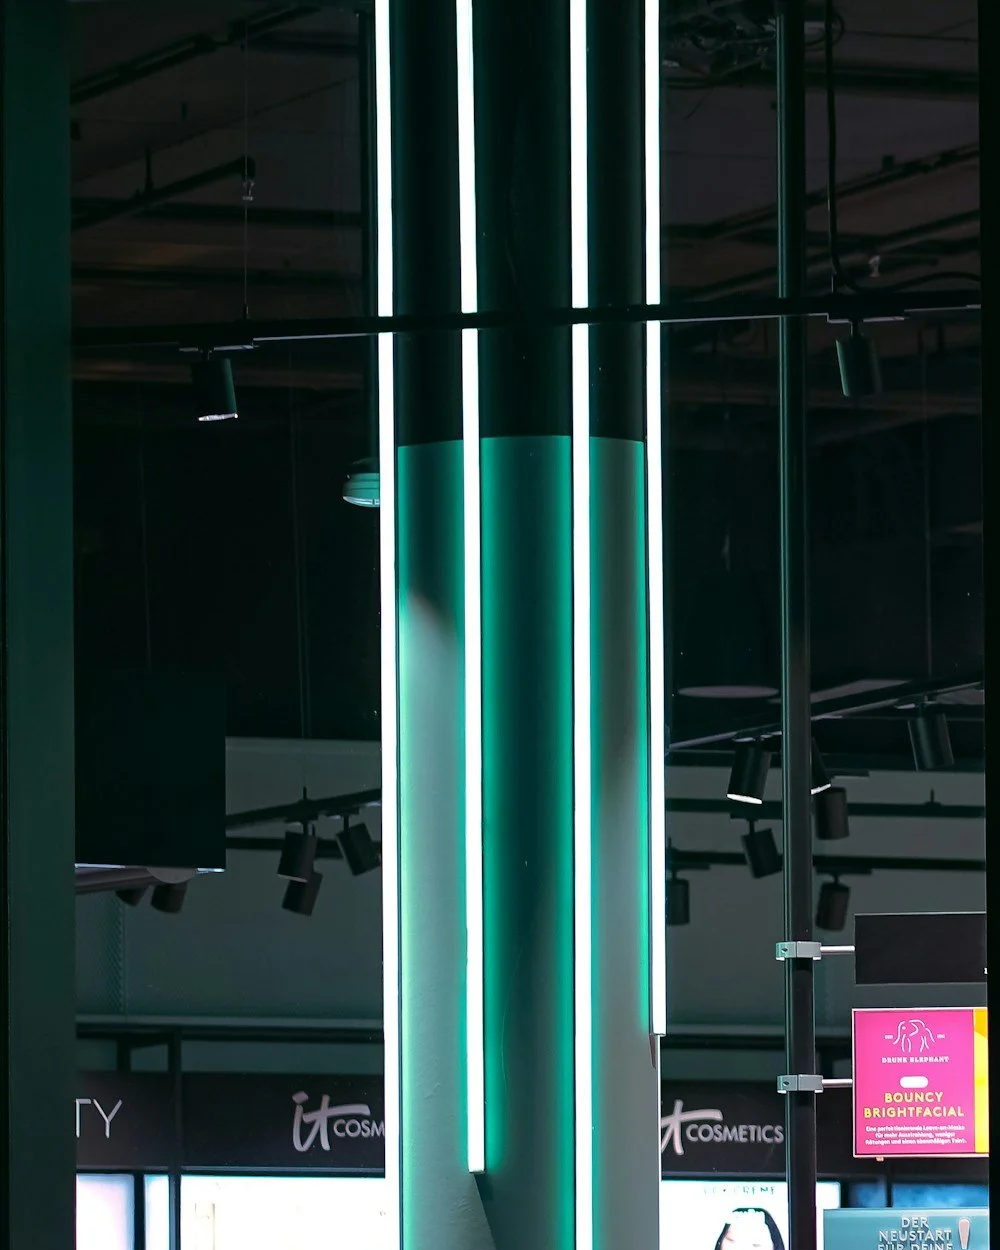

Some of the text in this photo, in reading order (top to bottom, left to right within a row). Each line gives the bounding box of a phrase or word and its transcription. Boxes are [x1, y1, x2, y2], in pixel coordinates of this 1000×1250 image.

[884, 1092, 944, 1103] BOUNCY
[864, 1106, 965, 1118] BRIGHTFACIAL
[685, 1123, 785, 1143] COSMETICS
[901, 1217, 929, 1228] DER
[879, 1230, 952, 1242] NEUSTART
